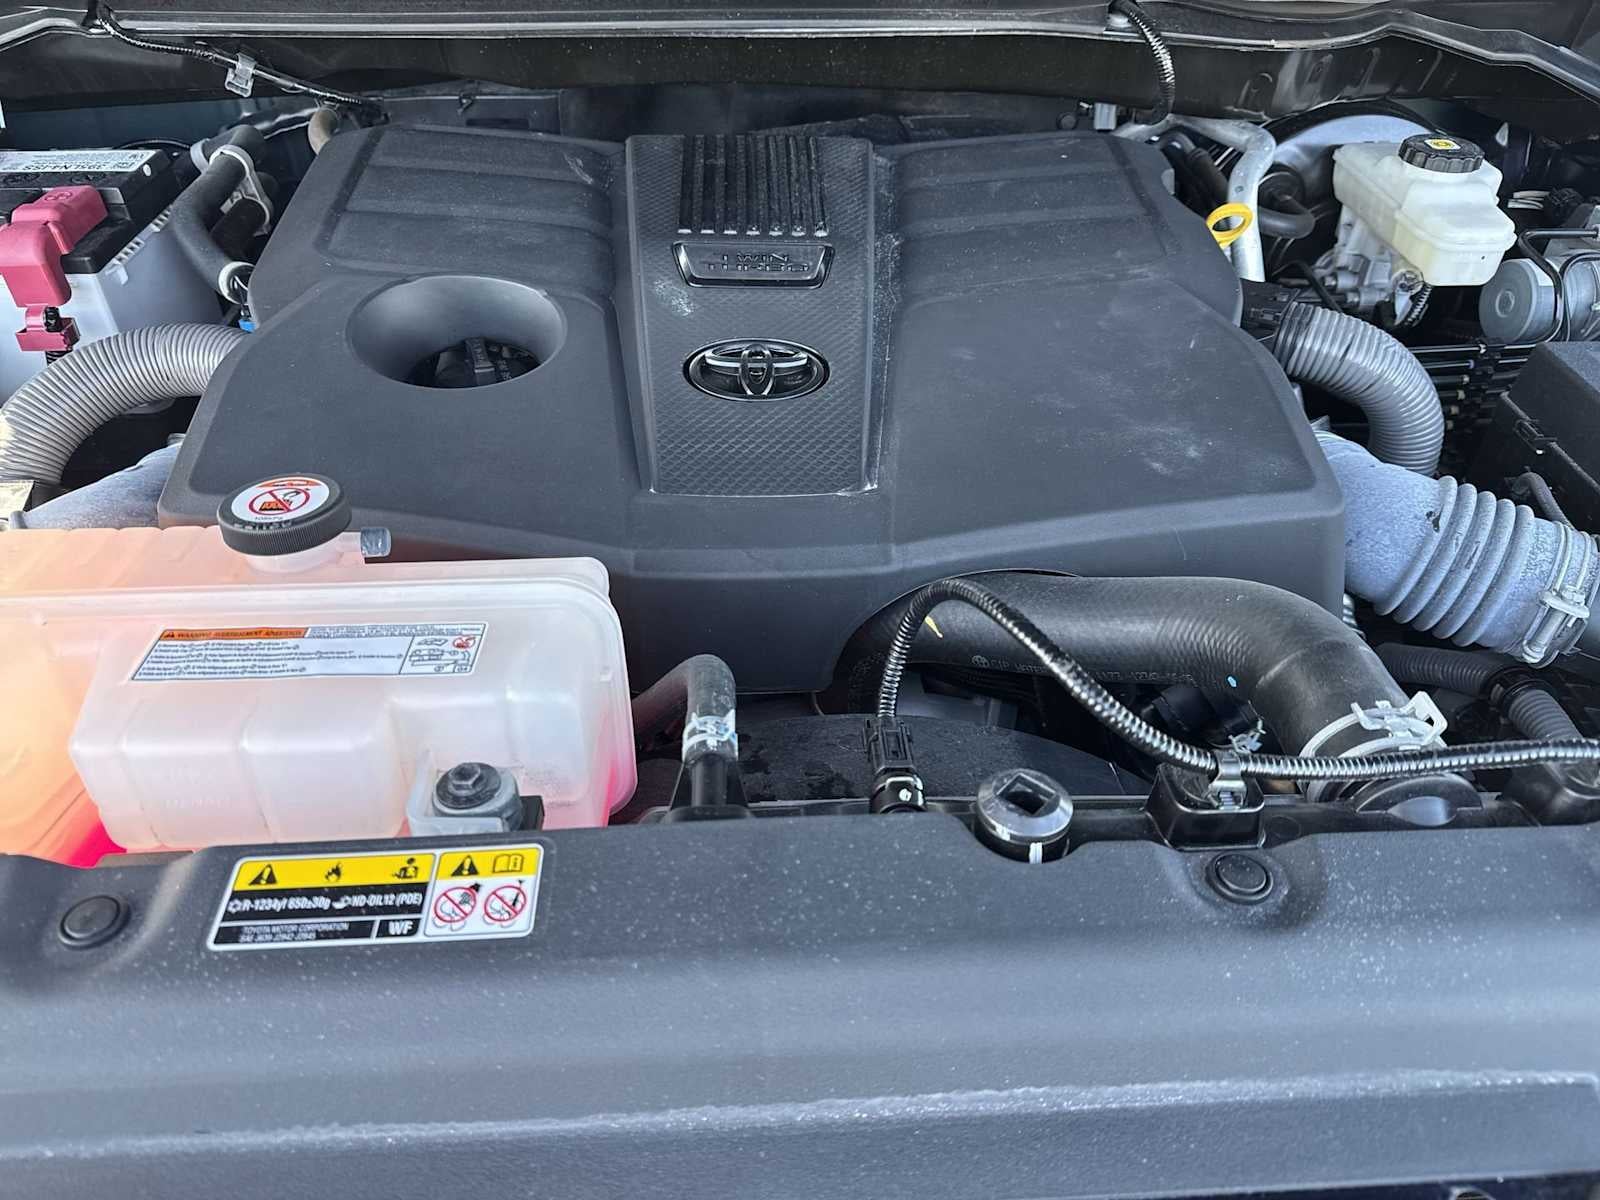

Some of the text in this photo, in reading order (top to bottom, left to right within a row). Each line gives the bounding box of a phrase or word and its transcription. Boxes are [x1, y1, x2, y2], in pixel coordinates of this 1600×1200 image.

[242, 922, 350, 933] TOYOTA MOTOR CORPORATION
[388, 919, 413, 936] WF
